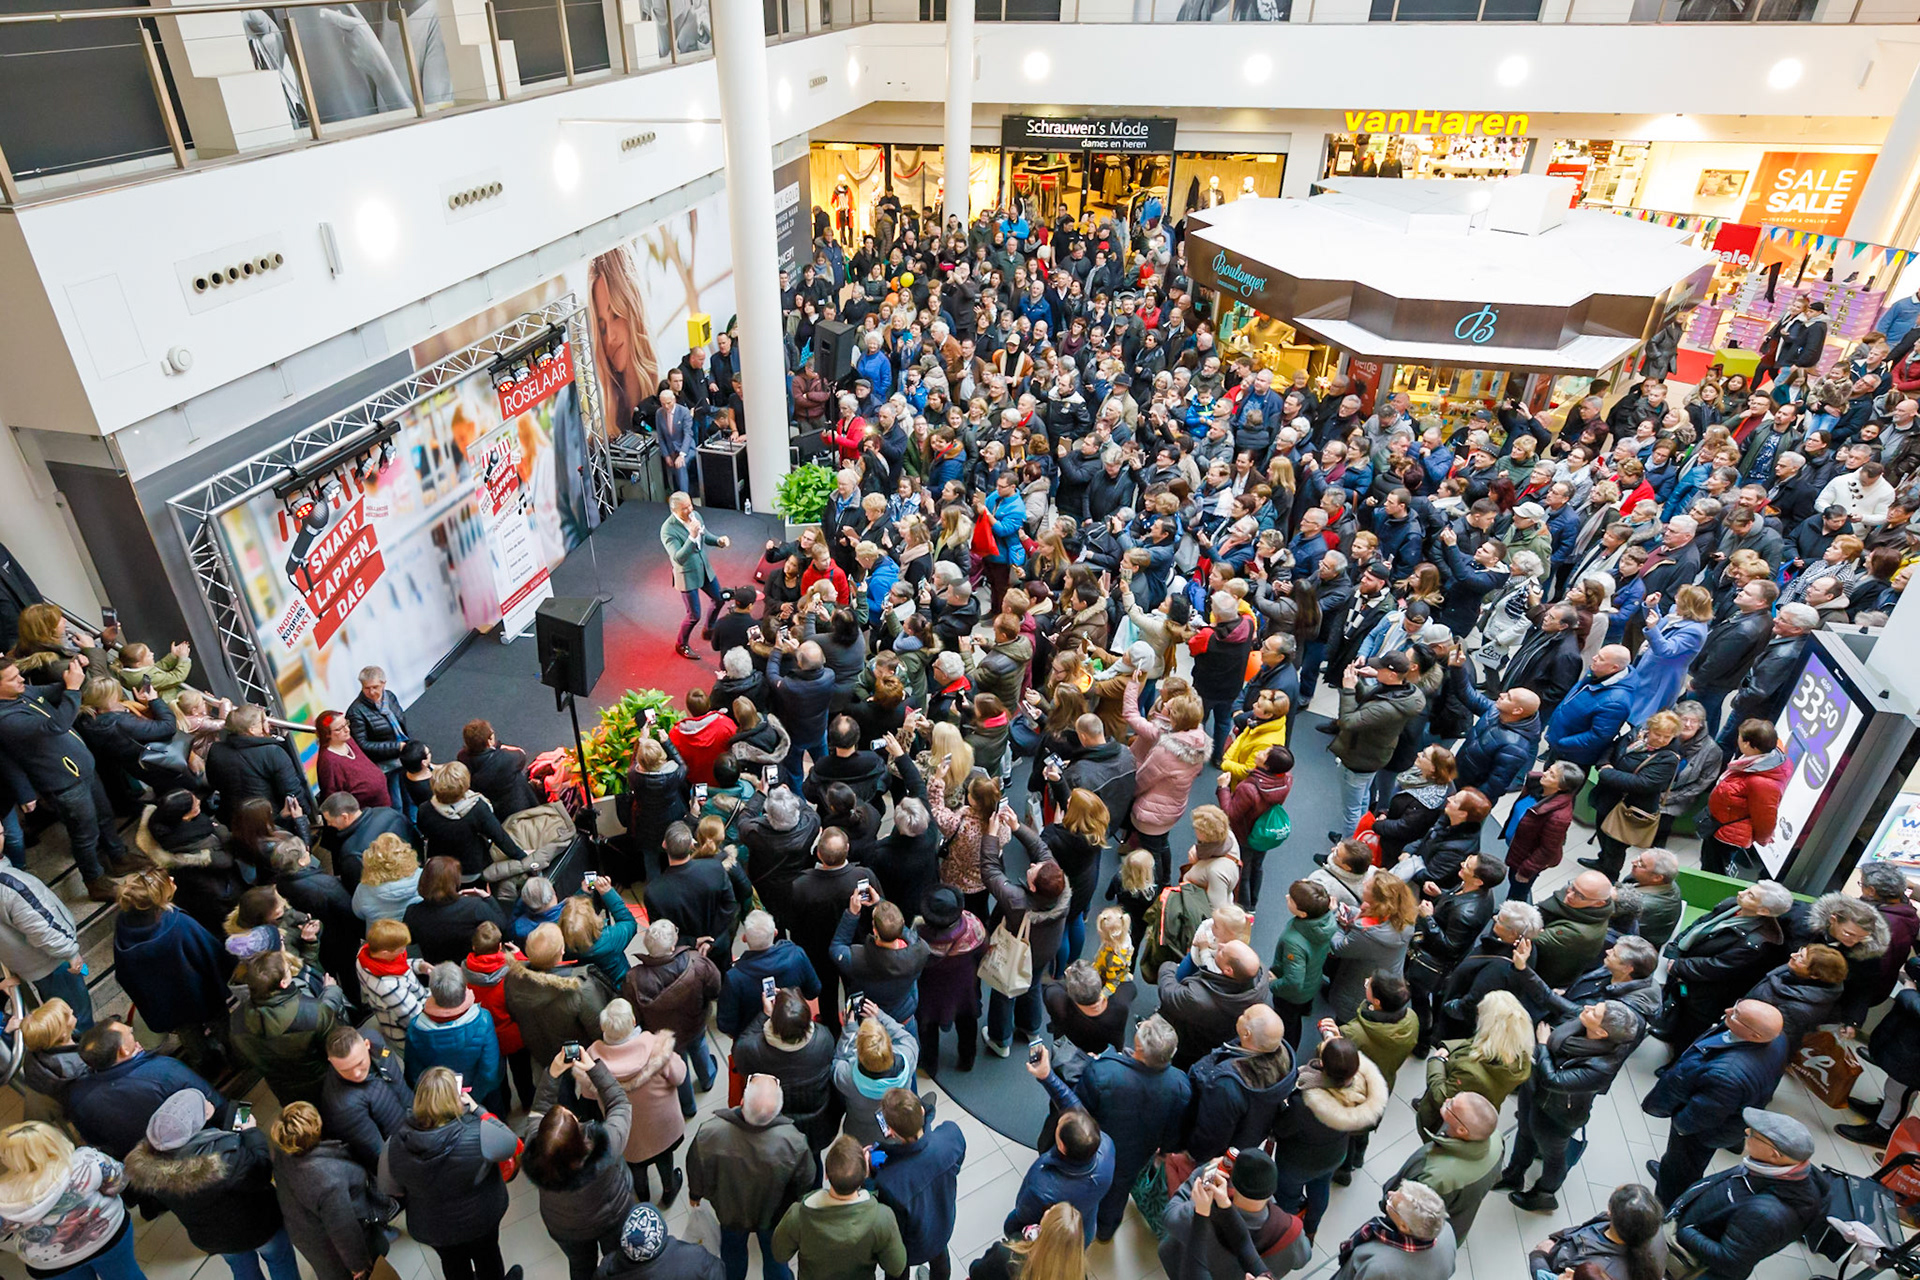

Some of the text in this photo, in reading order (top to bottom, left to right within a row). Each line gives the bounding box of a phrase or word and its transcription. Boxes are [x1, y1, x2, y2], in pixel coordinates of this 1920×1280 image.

[1027, 119, 1149, 136] Schrauwen's Mode
[1344, 109, 1529, 136] vanHaren
[1081, 139, 1109, 148] dames
[1122, 140, 1147, 149] heren
[1773, 168, 1858, 192] SALE
[1765, 191, 1848, 215] SALE
[1212, 250, 1267, 298] Boulanger
[503, 362, 568, 415] ROSELAAR
[311, 509, 358, 575] SMART
[315, 535, 370, 611] LAPPEN
[336, 576, 366, 620] DAG
[276, 599, 301, 635] INDOOR
[281, 606, 306, 642] KOOPJES
[286, 612, 312, 649] MARKT
